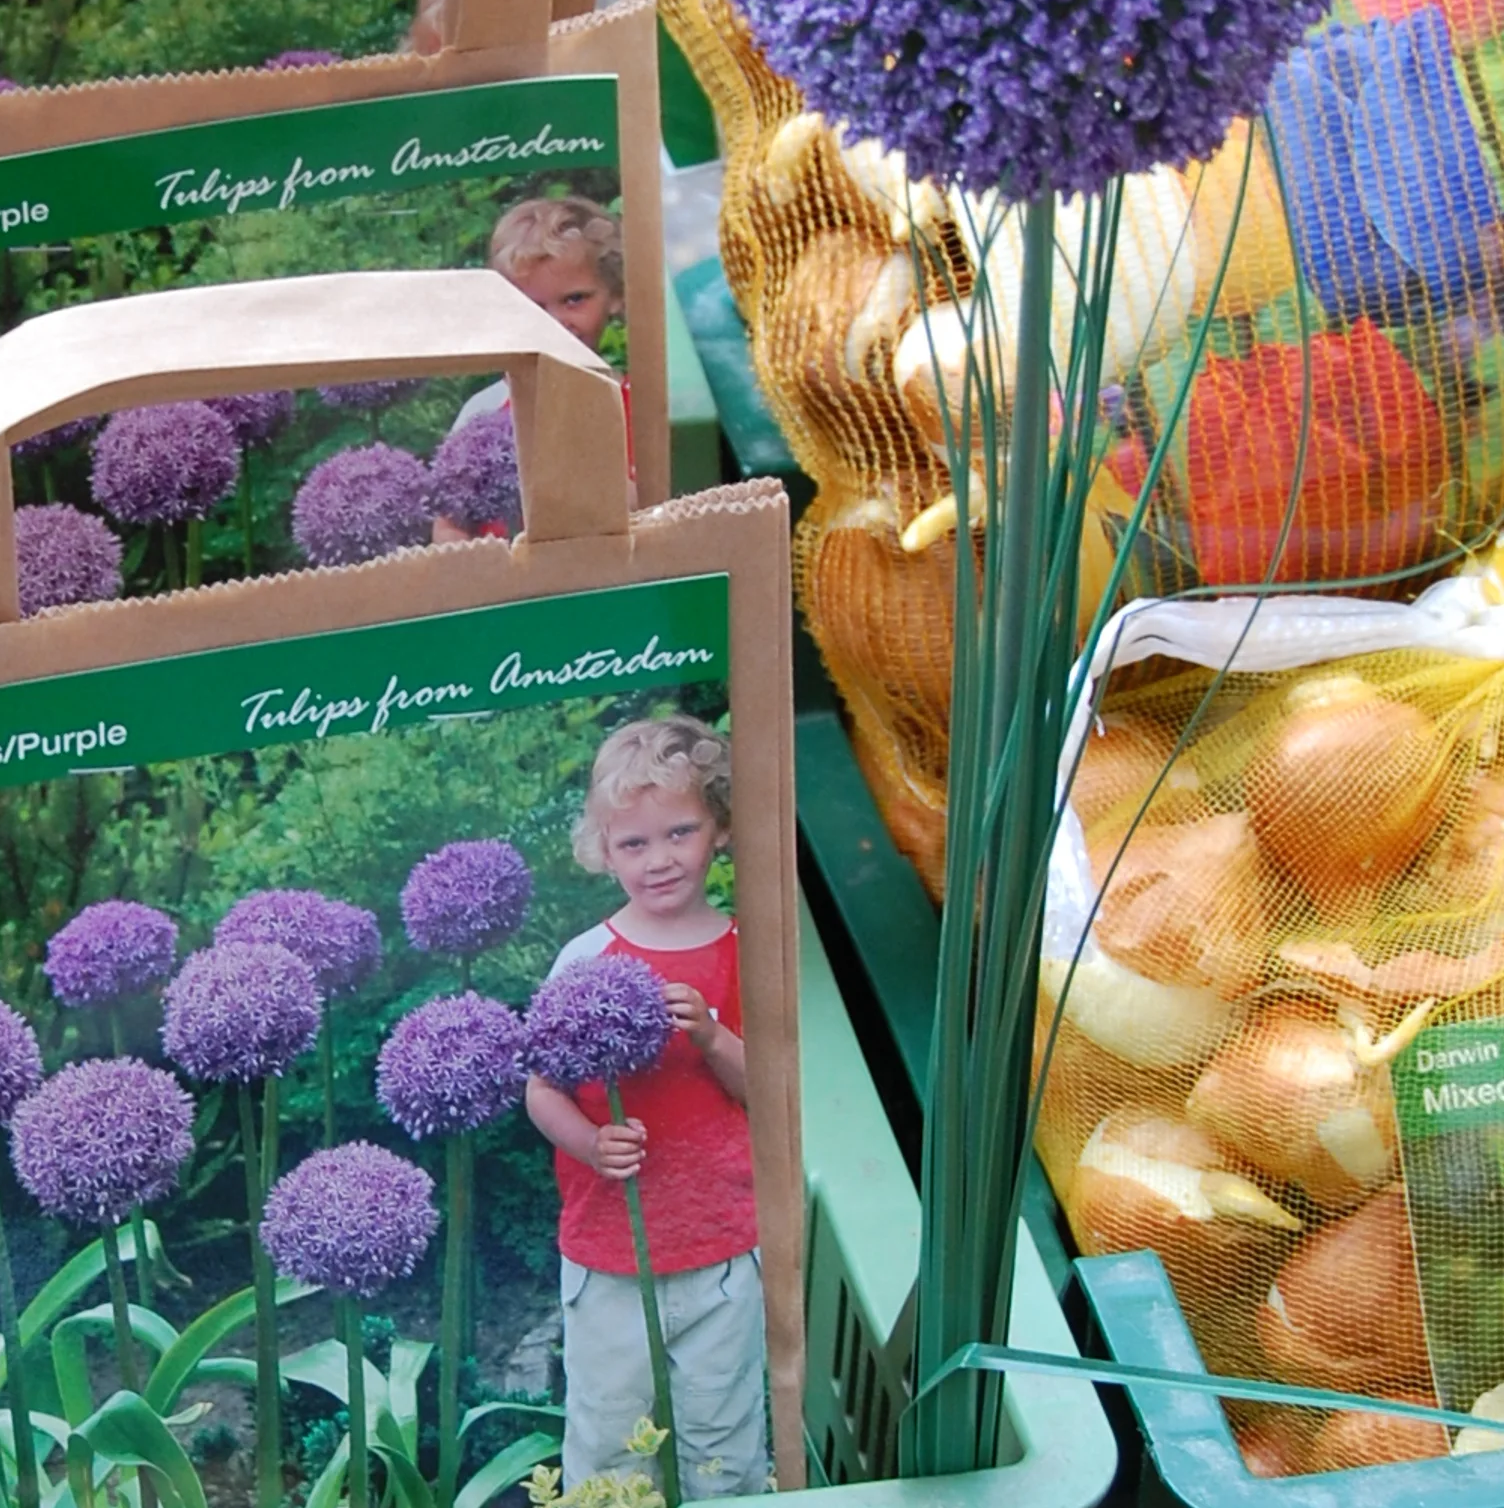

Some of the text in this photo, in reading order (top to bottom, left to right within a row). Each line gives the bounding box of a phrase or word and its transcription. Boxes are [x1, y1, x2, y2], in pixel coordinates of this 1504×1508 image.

[154, 123, 605, 214] Tulips from Amsterdam
[240, 635, 714, 738] Tulips from Amsterdam
[1417, 1040, 1499, 1073] Darwin
